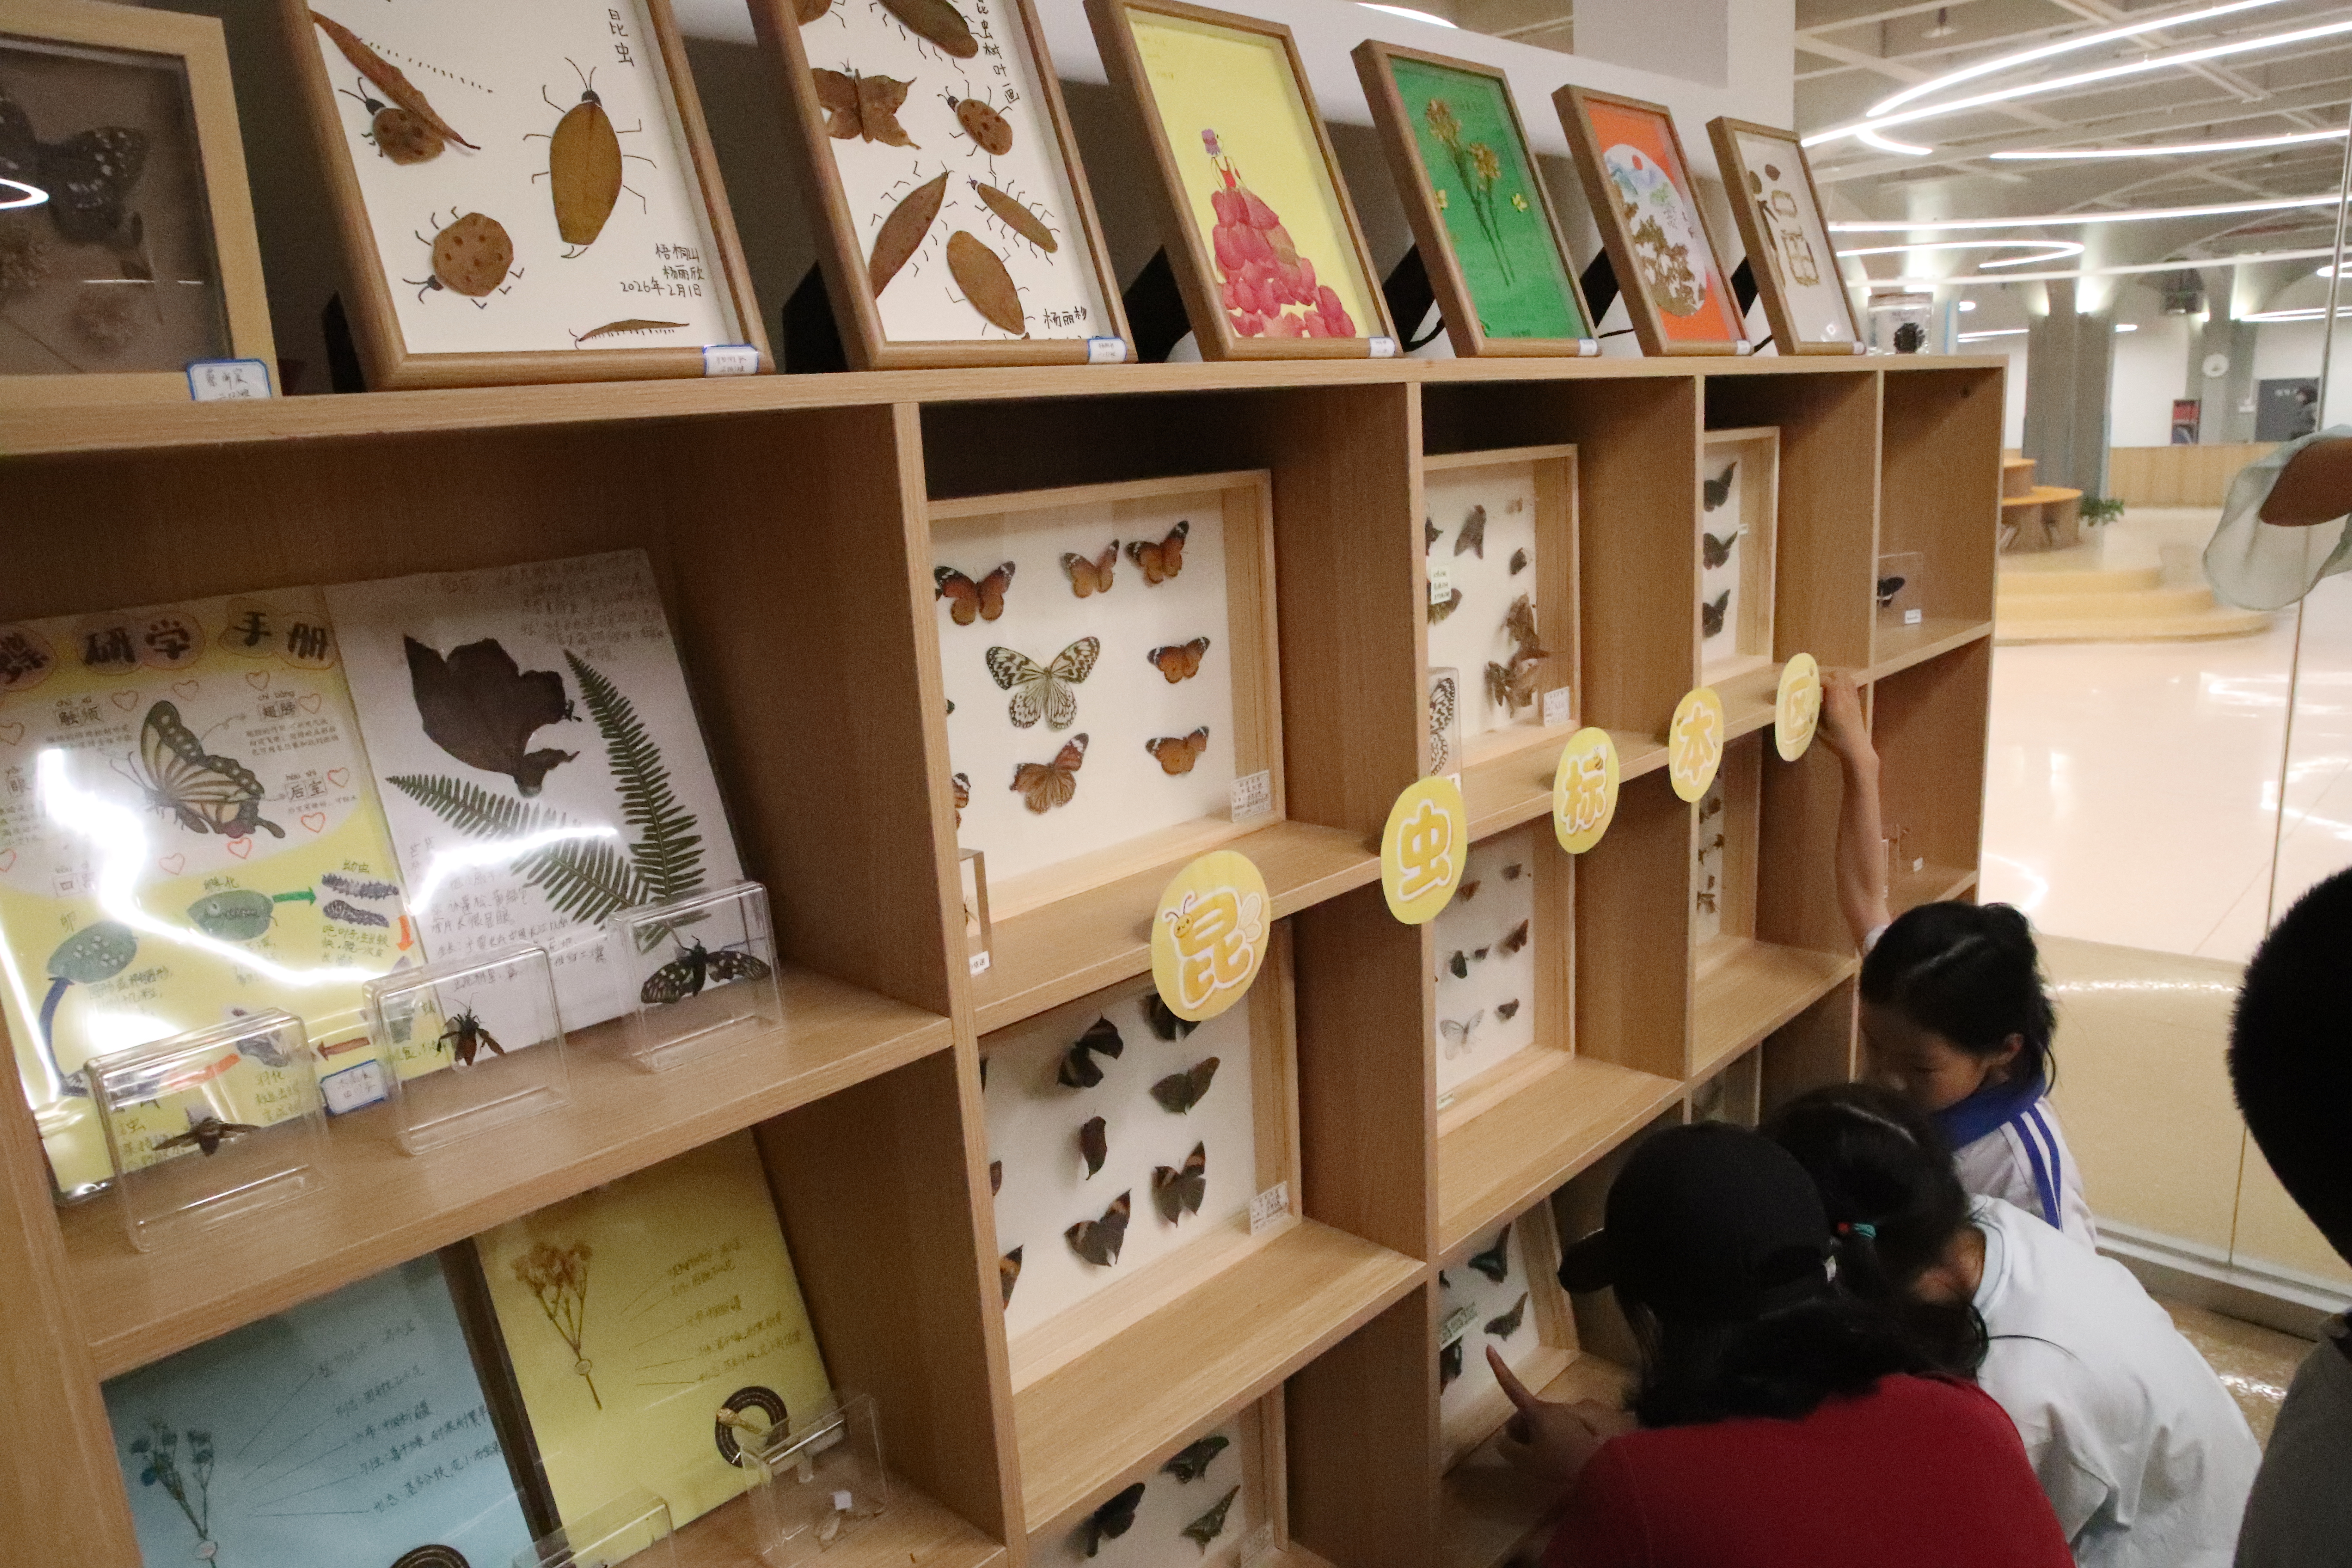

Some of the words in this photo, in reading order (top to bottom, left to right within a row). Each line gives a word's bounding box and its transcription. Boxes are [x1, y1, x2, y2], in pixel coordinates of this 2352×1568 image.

[608, 9, 634, 67] 昆虫
[343, 859, 370, 873] 幼虫
[1170, 885, 1255, 1010] 昆
[1398, 798, 1453, 901] 虫
[1561, 750, 1608, 836] 标
[1675, 701, 1715, 787] 本
[1783, 673, 1811, 744] 区
